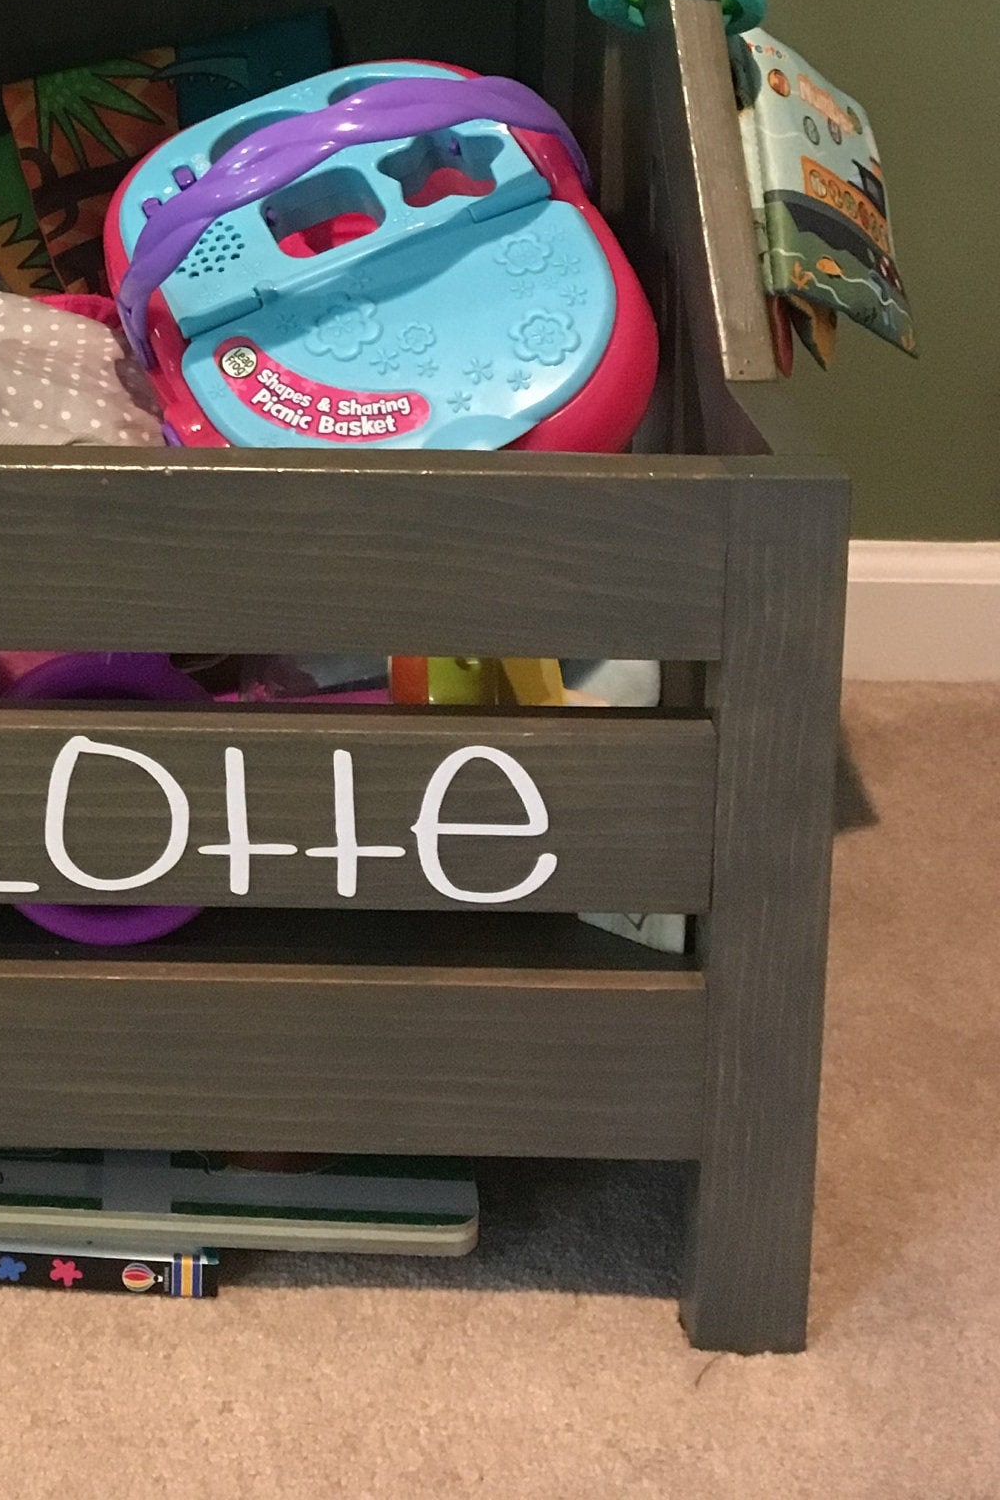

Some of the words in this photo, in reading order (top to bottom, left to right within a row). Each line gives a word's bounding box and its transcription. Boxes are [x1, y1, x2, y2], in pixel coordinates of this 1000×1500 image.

[225, 356, 246, 377] Frog
[233, 348, 255, 368] Leap
[257, 368, 312, 407] Shapes
[317, 397, 331, 412] &
[337, 396, 411, 416] Sharing
[251, 388, 312, 429] Picnic
[318, 416, 397, 436] Basket
